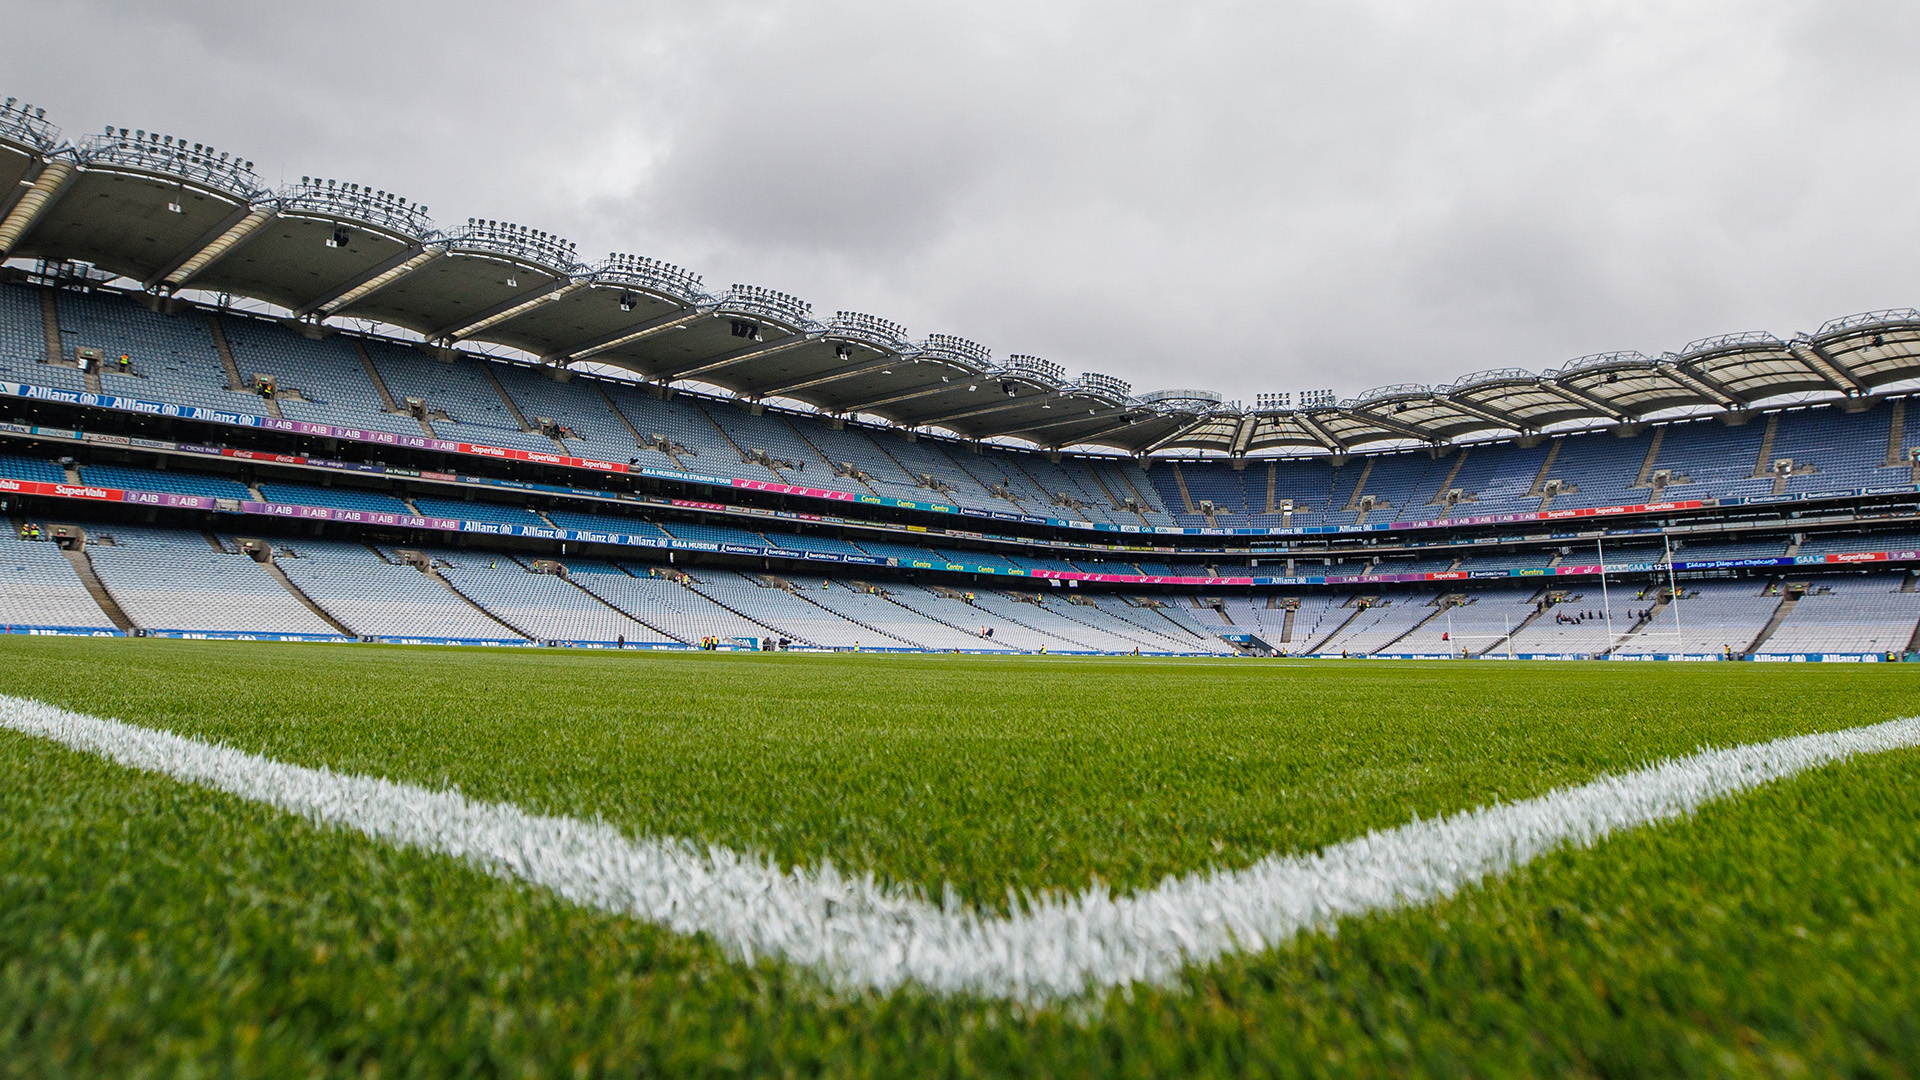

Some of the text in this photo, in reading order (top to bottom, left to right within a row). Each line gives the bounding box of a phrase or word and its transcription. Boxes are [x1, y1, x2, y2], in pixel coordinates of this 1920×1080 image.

[26, 386, 78, 404] Allianz
[112, 396, 160, 414] Allianz
[192, 408, 237, 424] Allianz
[275, 420, 293, 430] AIB
[310, 425, 327, 434] AIB
[344, 430, 360, 438] AIB
[377, 434, 393, 442] AIB
[410, 438, 425, 447] AIB
[440, 442, 455, 450] AIB
[470, 446, 505, 456] SuperValu
[528, 452, 560, 463] SuperValu
[582, 460, 613, 470] SuperValu
[656, 470, 683, 479] MUSEUM
[689, 474, 715, 483] STADIUM
[55, 485, 106, 498] SuperValu
[139, 494, 159, 503] AIB
[179, 497, 198, 506] AIB
[861, 496, 880, 504] Centra
[897, 500, 916, 508] Centra
[930, 504, 949, 512] Centra
[1644, 502, 1674, 510] SuperValu
[275, 506, 292, 514] AIB
[310, 509, 327, 517] AIB
[345, 512, 361, 520] AIB
[464, 521, 498, 533] Allianz
[522, 526, 554, 538] Allianz
[576, 531, 606, 543] Allianz
[627, 536, 656, 547] Allianz
[689, 542, 718, 551] MUSEUM
[1837, 553, 1875, 562] SuperValu
